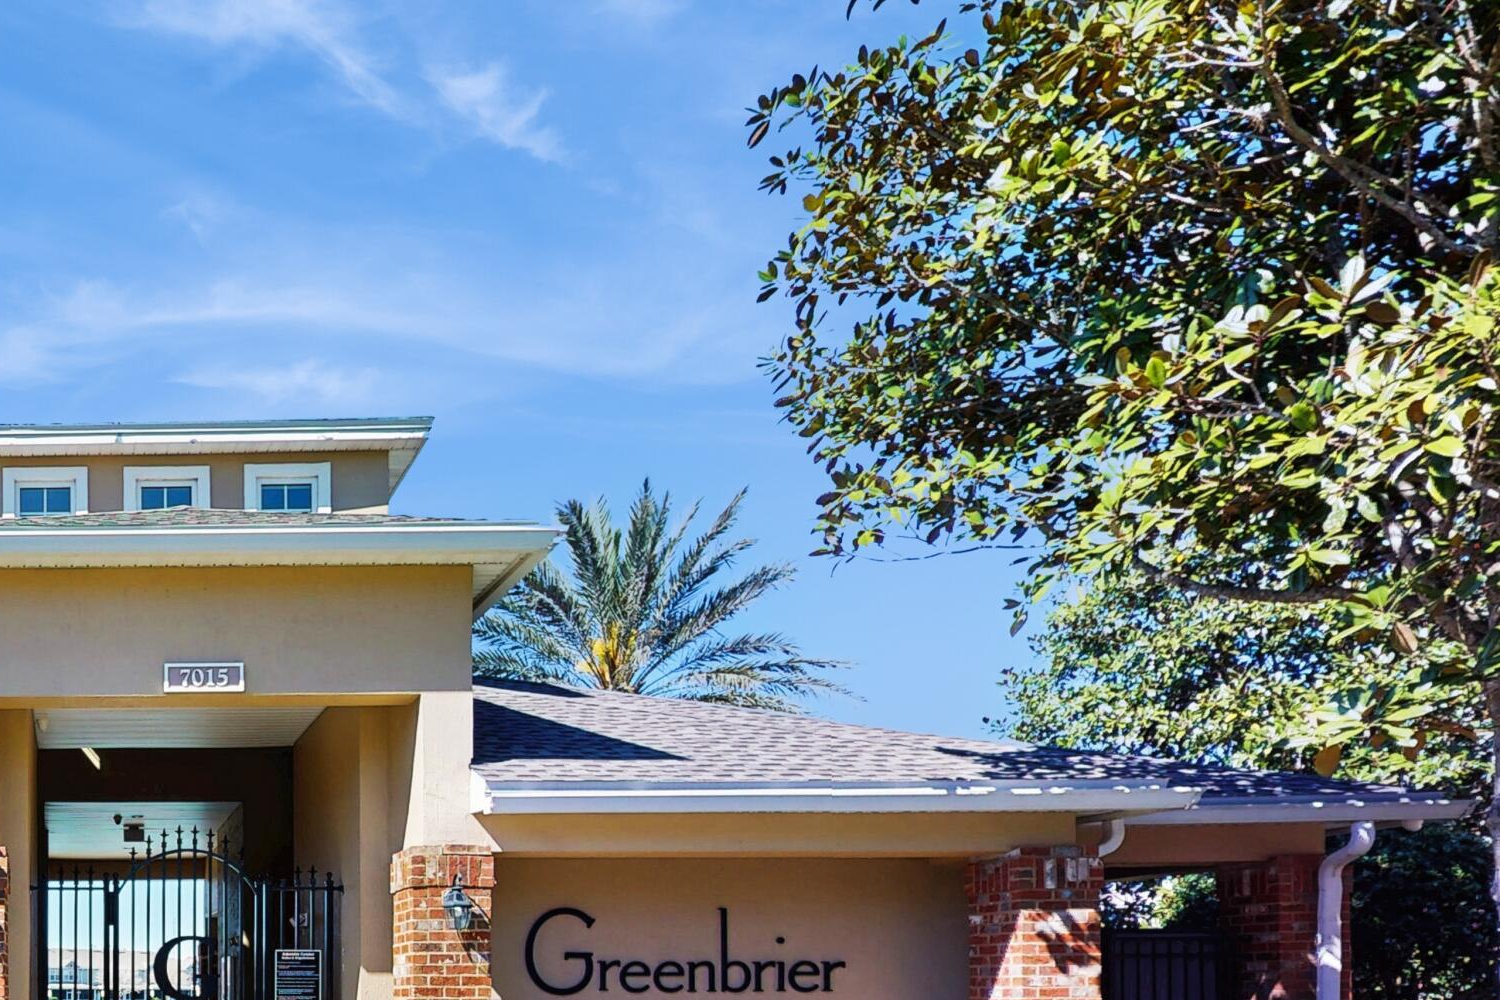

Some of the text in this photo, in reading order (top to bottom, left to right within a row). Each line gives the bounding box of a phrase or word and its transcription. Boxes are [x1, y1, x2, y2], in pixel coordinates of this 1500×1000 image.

[179, 668, 229, 687] 7015
[153, 936, 220, 1000] G
[524, 906, 846, 996] Greenbrier
